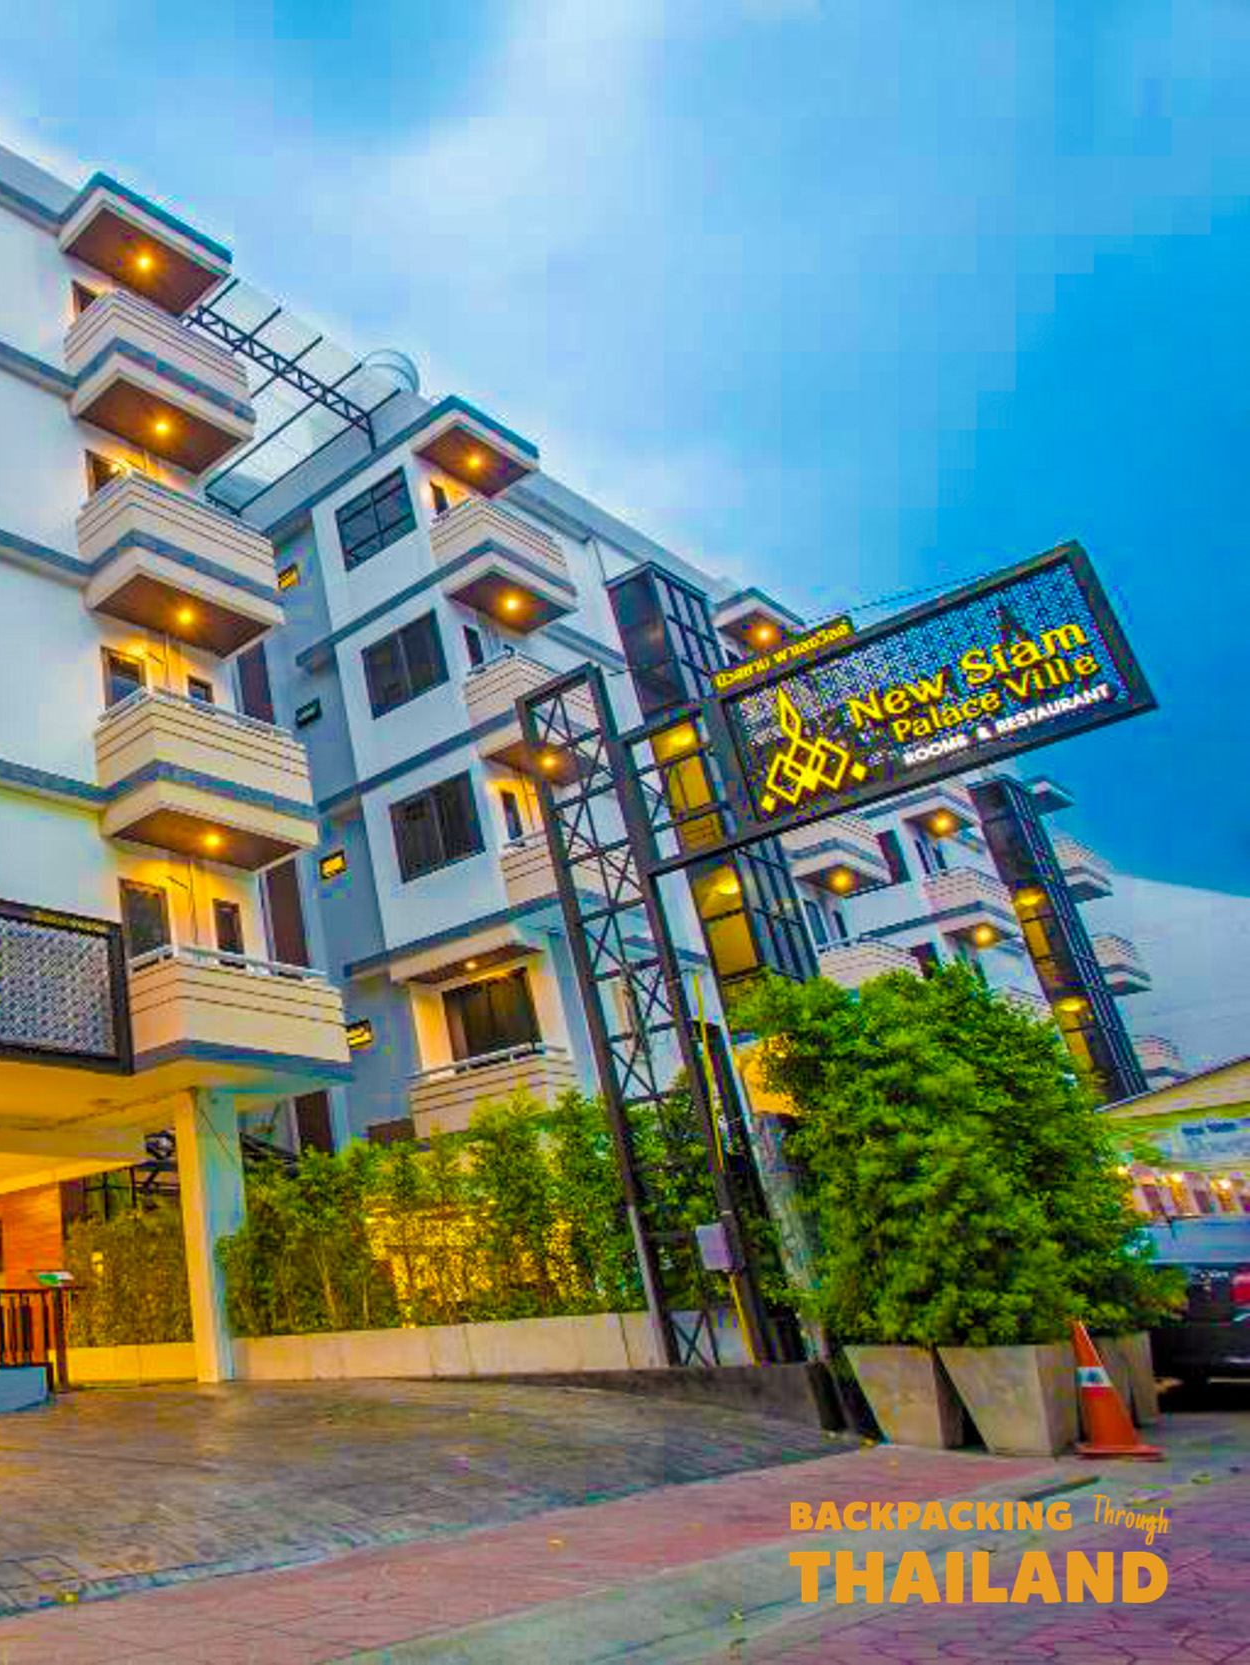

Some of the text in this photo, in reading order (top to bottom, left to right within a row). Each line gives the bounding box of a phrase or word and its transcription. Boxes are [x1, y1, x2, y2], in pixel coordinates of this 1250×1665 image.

[850, 624, 1089, 728] New Siam
[893, 656, 1099, 741] Palace Ville
[903, 734, 968, 765] ROOMS
[995, 683, 1110, 733] RESTAURANT
